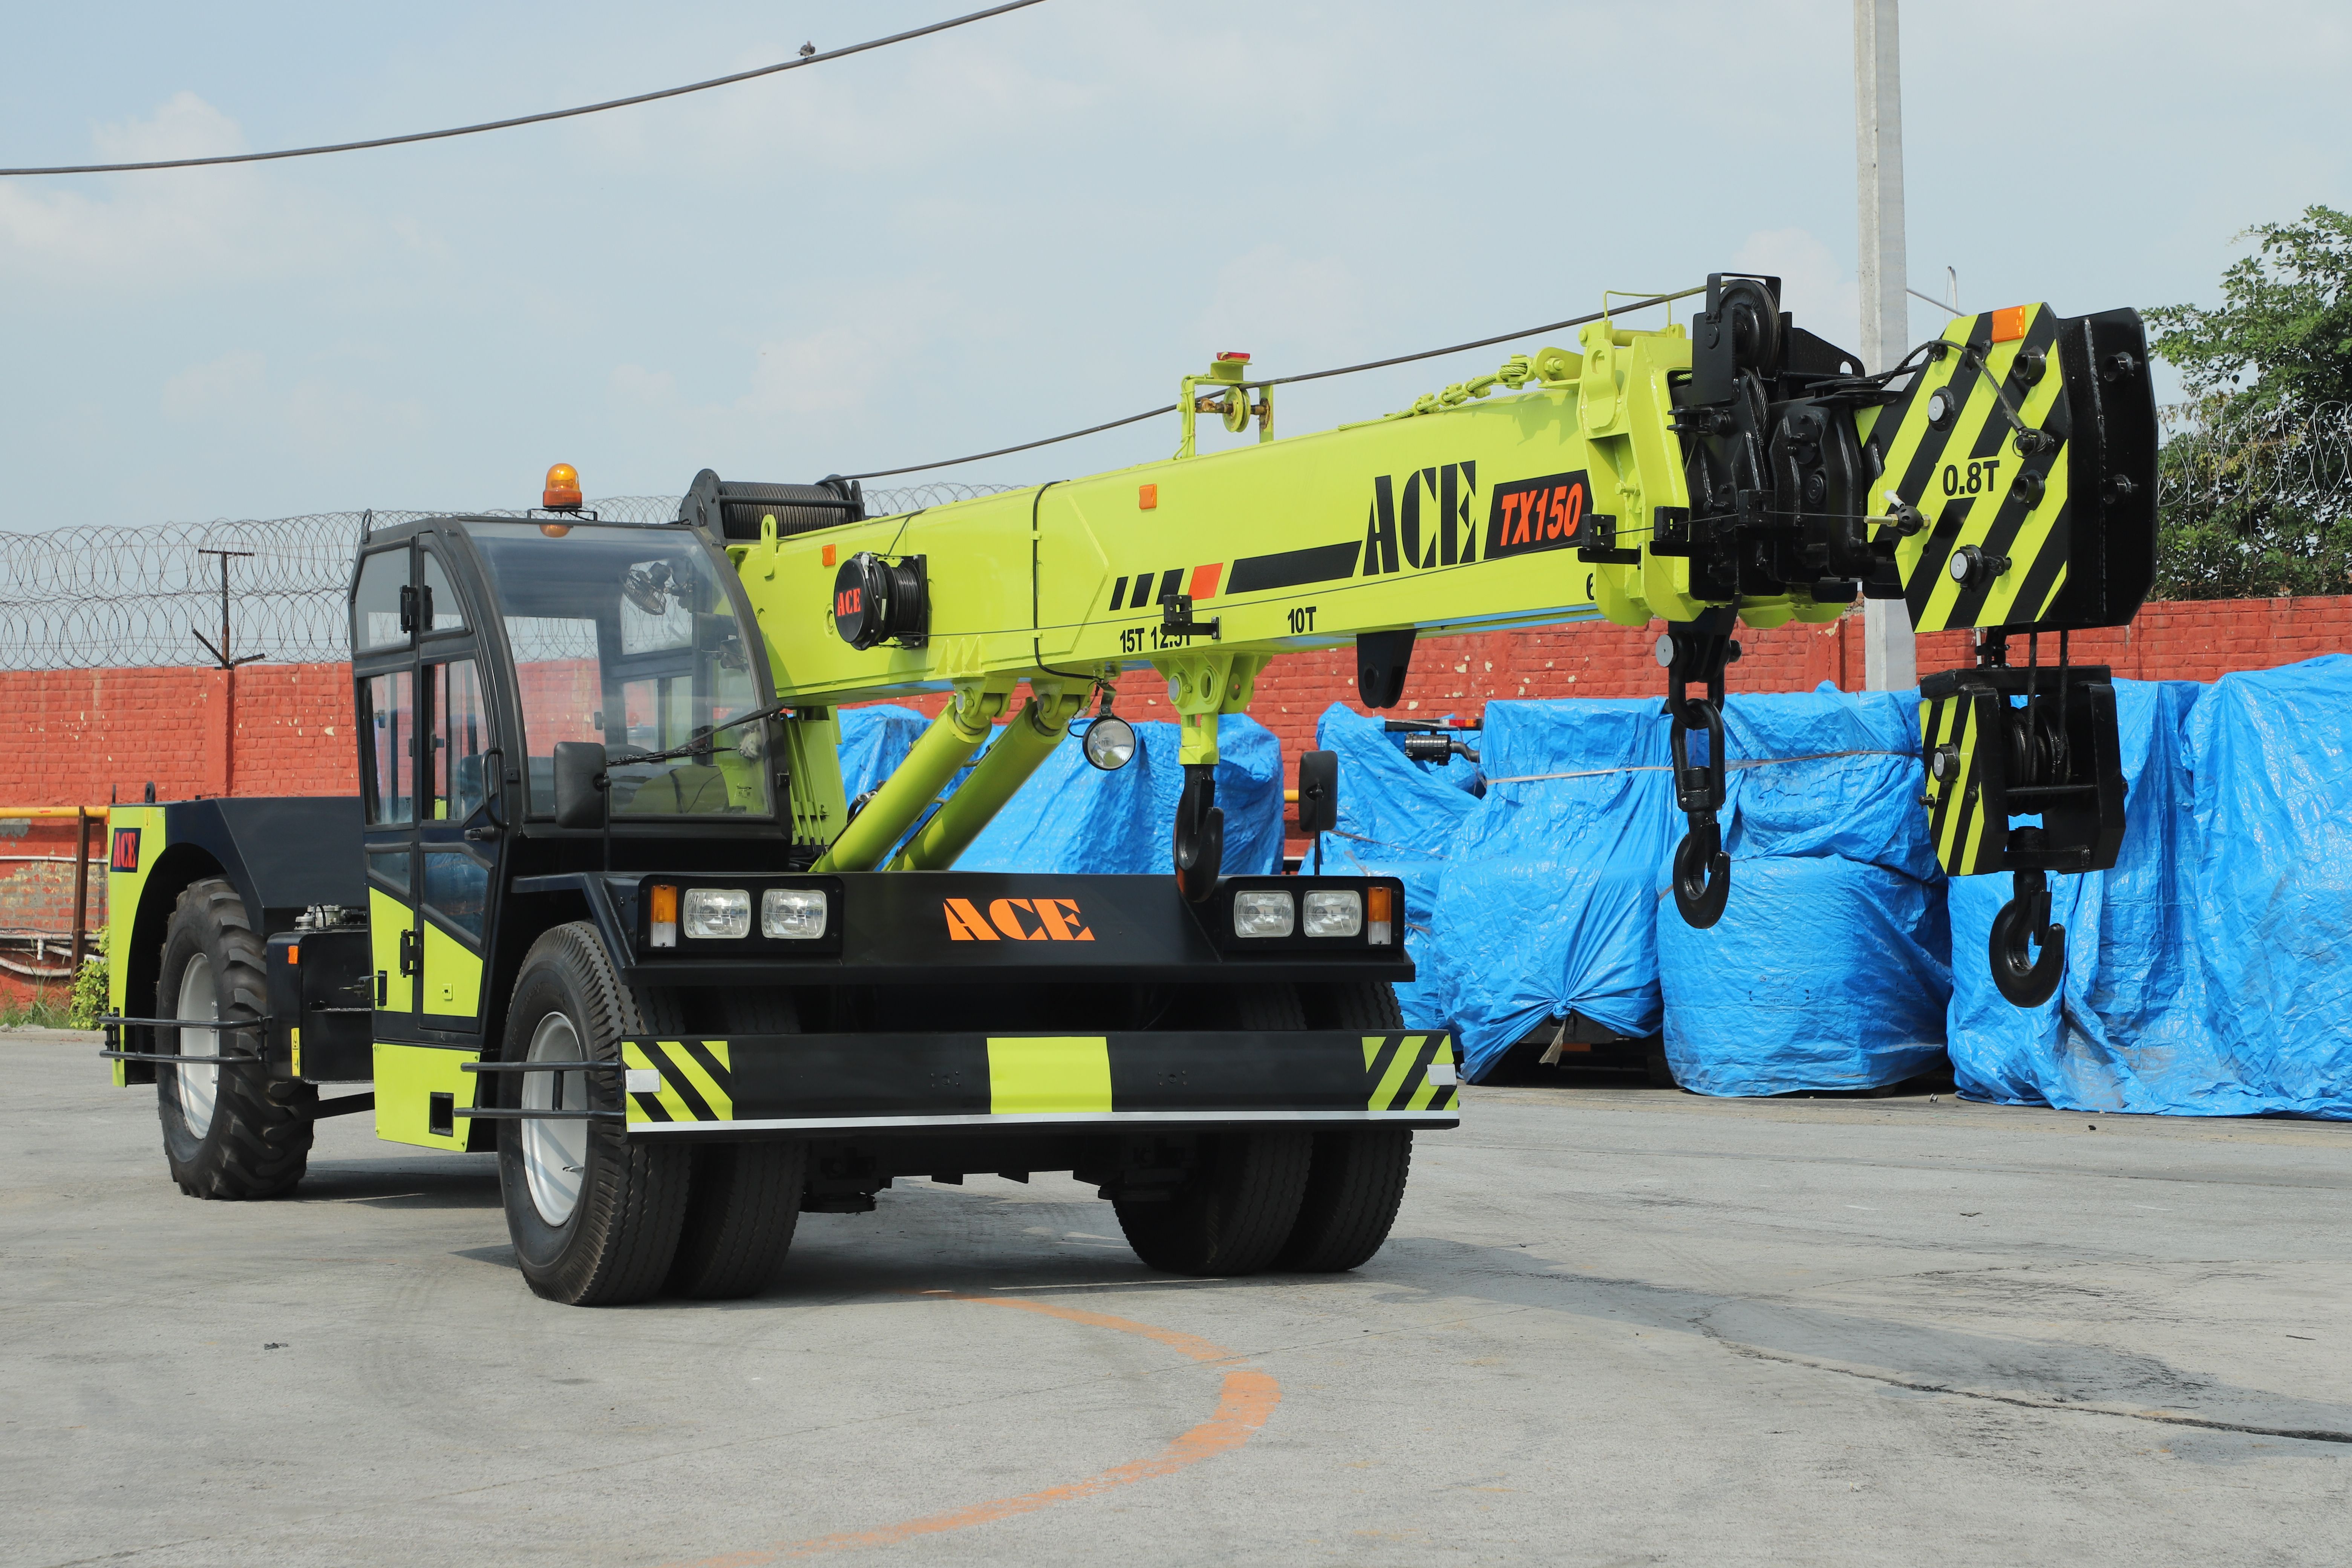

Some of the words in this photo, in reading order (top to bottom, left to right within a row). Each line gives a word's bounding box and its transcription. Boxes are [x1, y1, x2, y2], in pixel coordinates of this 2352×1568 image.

[1943, 460, 2000, 496] 0.8T
[1363, 461, 1475, 576] ACE
[1501, 483, 1583, 546] TX150
[837, 588, 861, 616] ACE
[1288, 606, 1316, 634] 10T
[1120, 628, 1145, 653] 15T
[113, 832, 136, 868] ACE
[943, 898, 1095, 941] ACE
